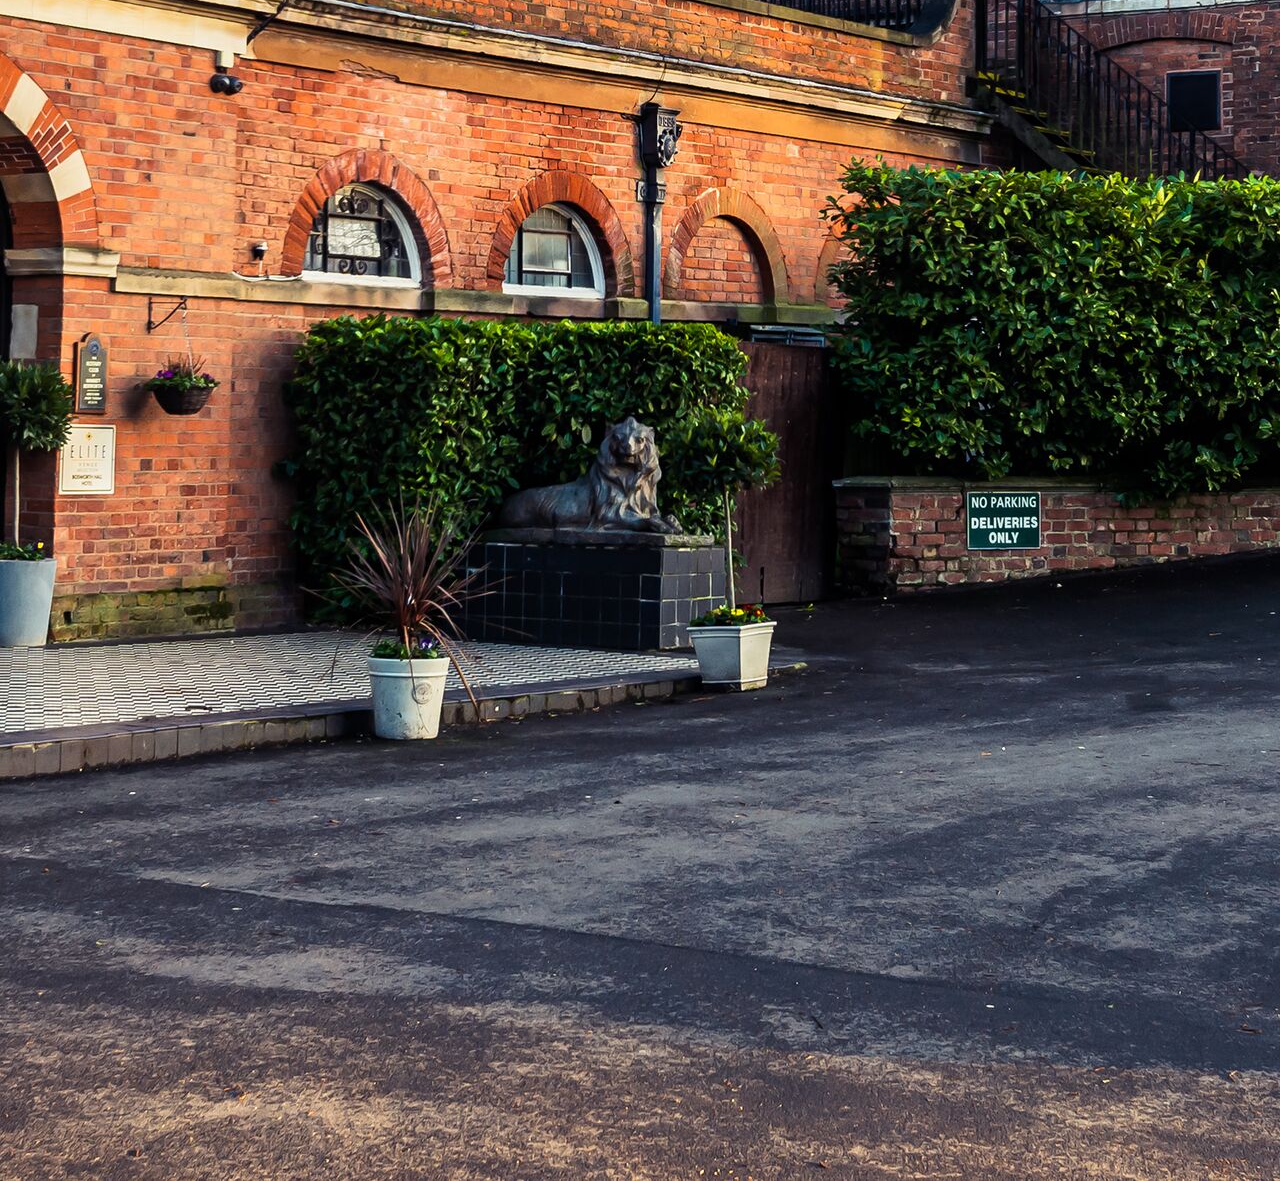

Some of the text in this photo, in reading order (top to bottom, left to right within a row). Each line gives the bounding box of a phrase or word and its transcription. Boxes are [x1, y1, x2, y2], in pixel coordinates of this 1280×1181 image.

[70, 444, 106, 459] ELITE
[971, 496, 1037, 509] NO PARKING
[971, 516, 1038, 529] DELIVERIES
[988, 532, 1019, 544] ONLY
